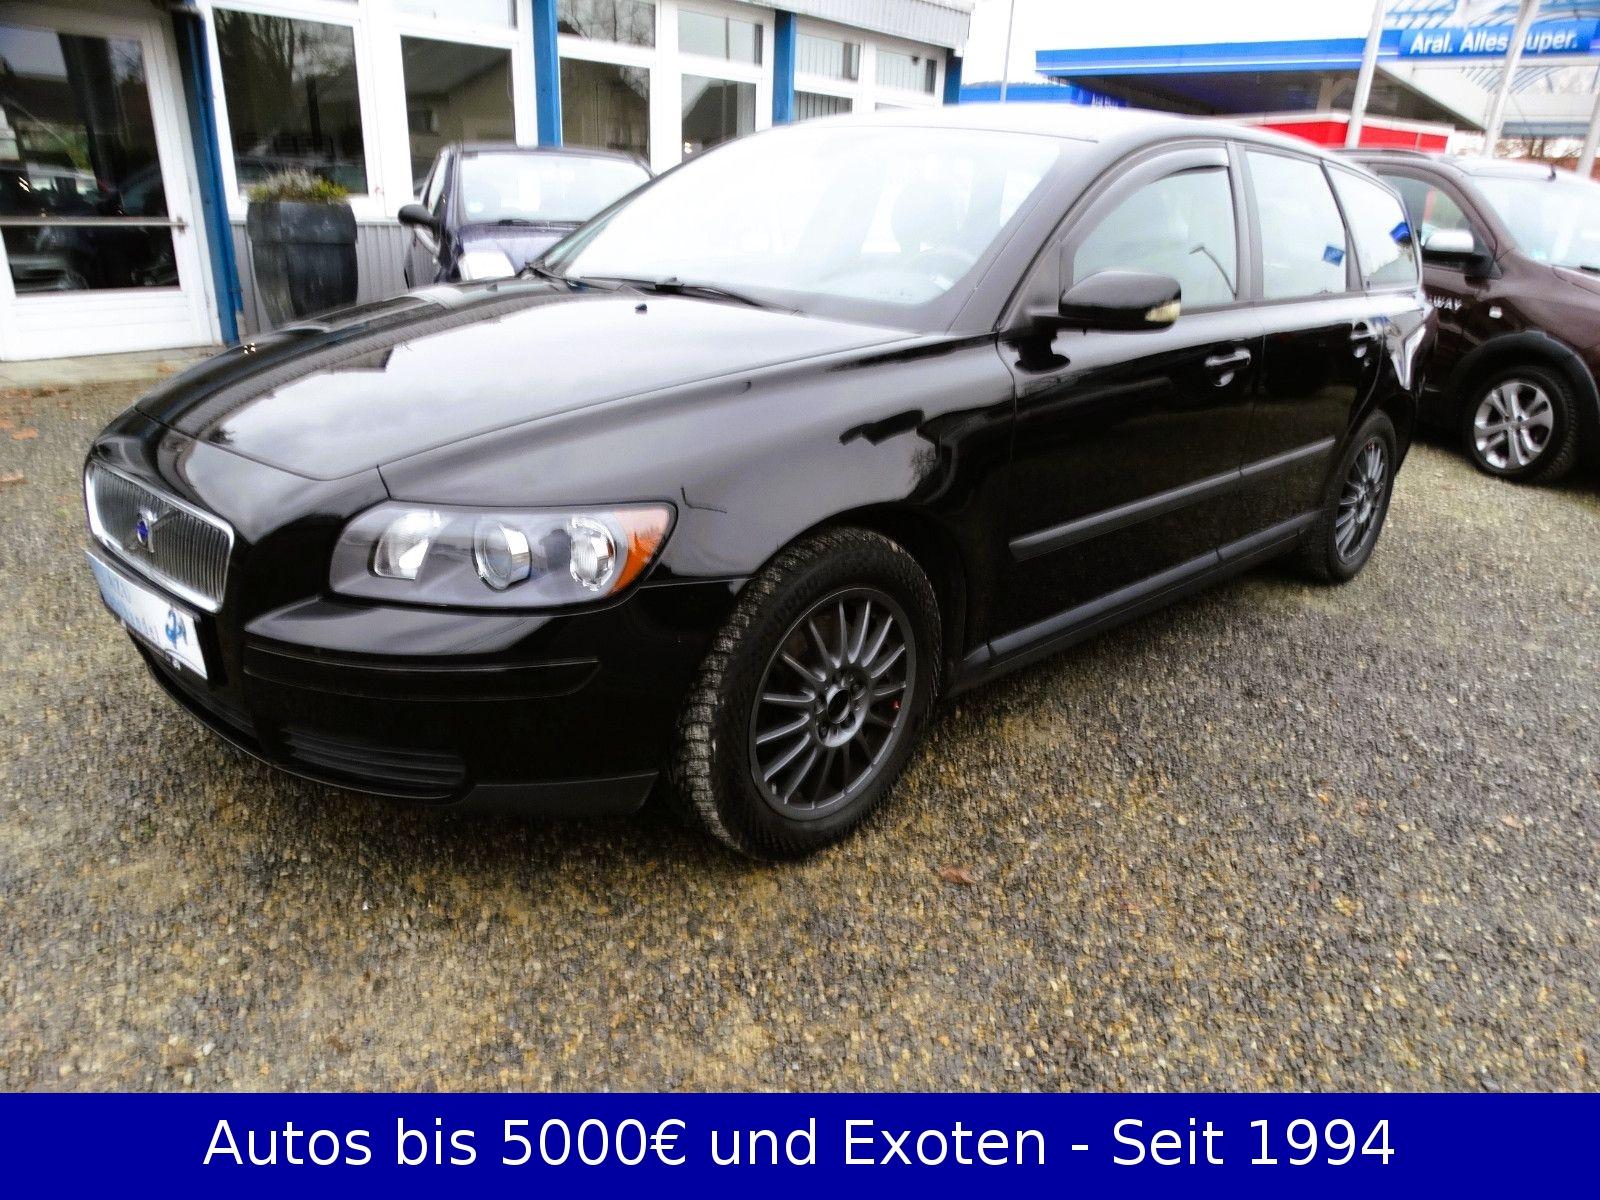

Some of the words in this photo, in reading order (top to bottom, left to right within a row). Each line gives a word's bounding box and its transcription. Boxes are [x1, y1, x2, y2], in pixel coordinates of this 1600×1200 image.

[1409, 32, 1453, 54] Aral.
[1459, 30, 1508, 53] Alles
[1518, 29, 1578, 53] uper.
[1432, 295, 1463, 311] WAY
